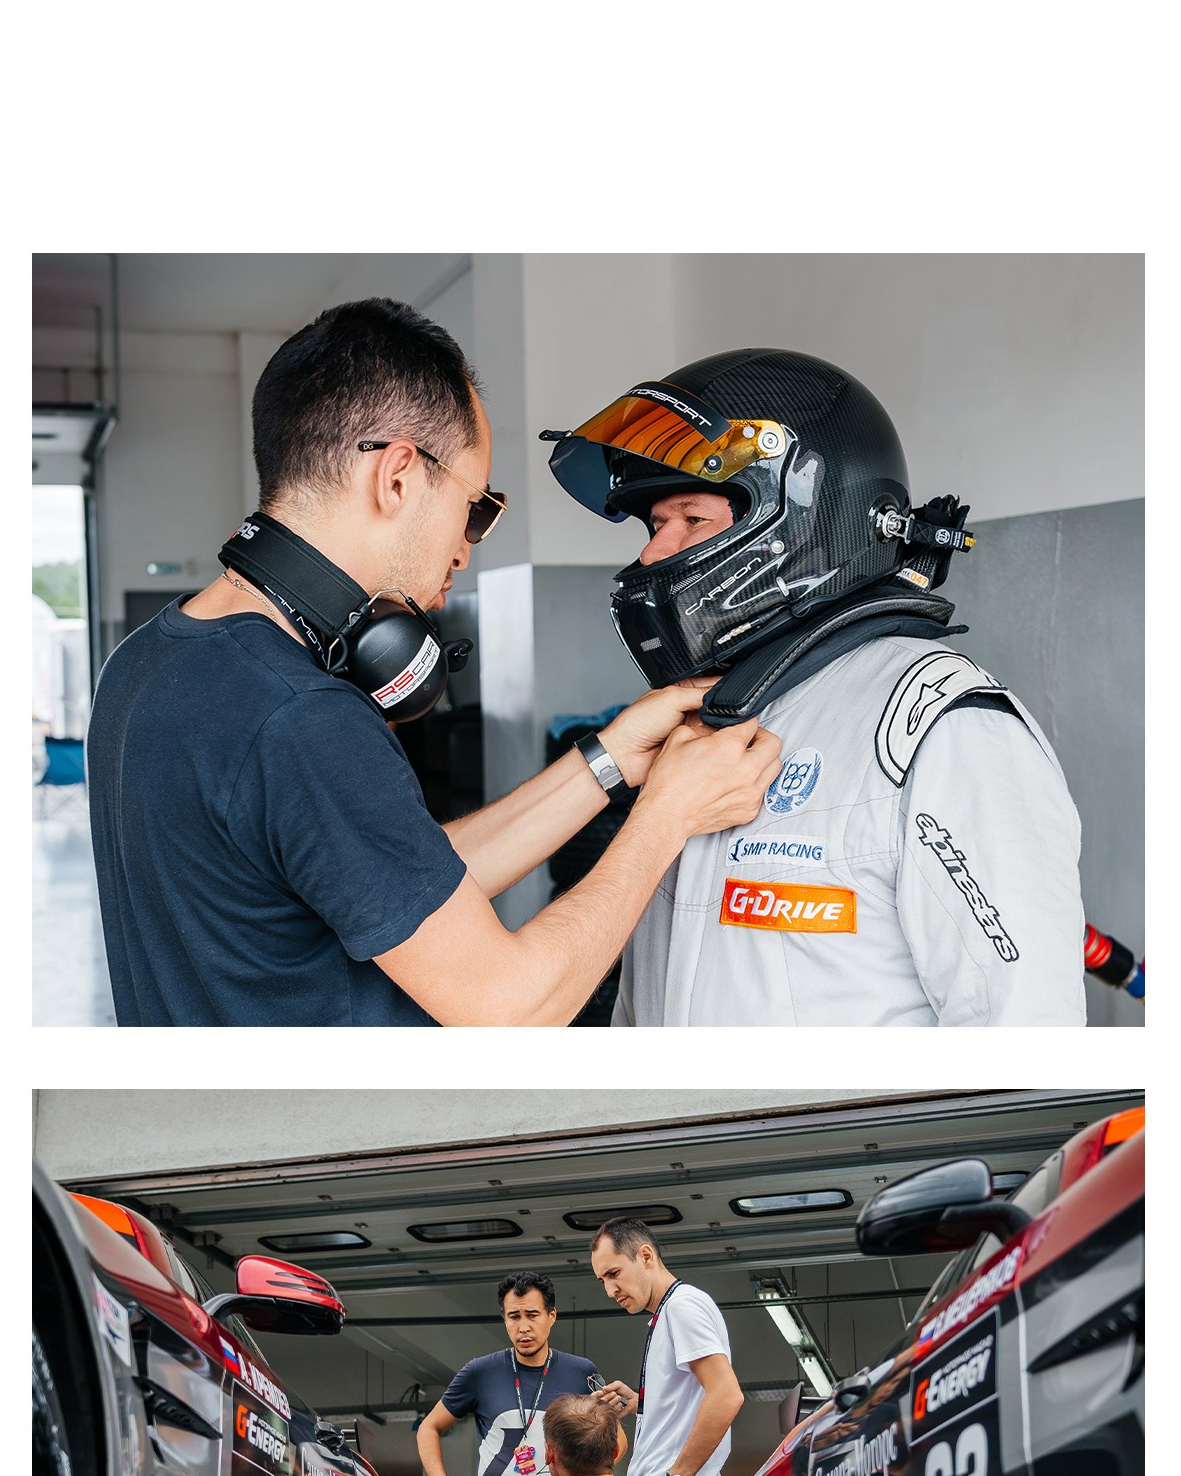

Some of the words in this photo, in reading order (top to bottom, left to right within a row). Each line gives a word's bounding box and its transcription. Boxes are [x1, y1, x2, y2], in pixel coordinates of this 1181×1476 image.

[627, 388, 712, 427] TORSPORT
[685, 557, 762, 615] CARBON
[909, 572, 929, 587] 047
[375, 641, 435, 702] RSCAR
[741, 842, 767, 856] SMP
[768, 842, 824, 861] RACING
[915, 813, 1020, 962] alpinestars
[236, 1404, 287, 1463] G-ENERGY
